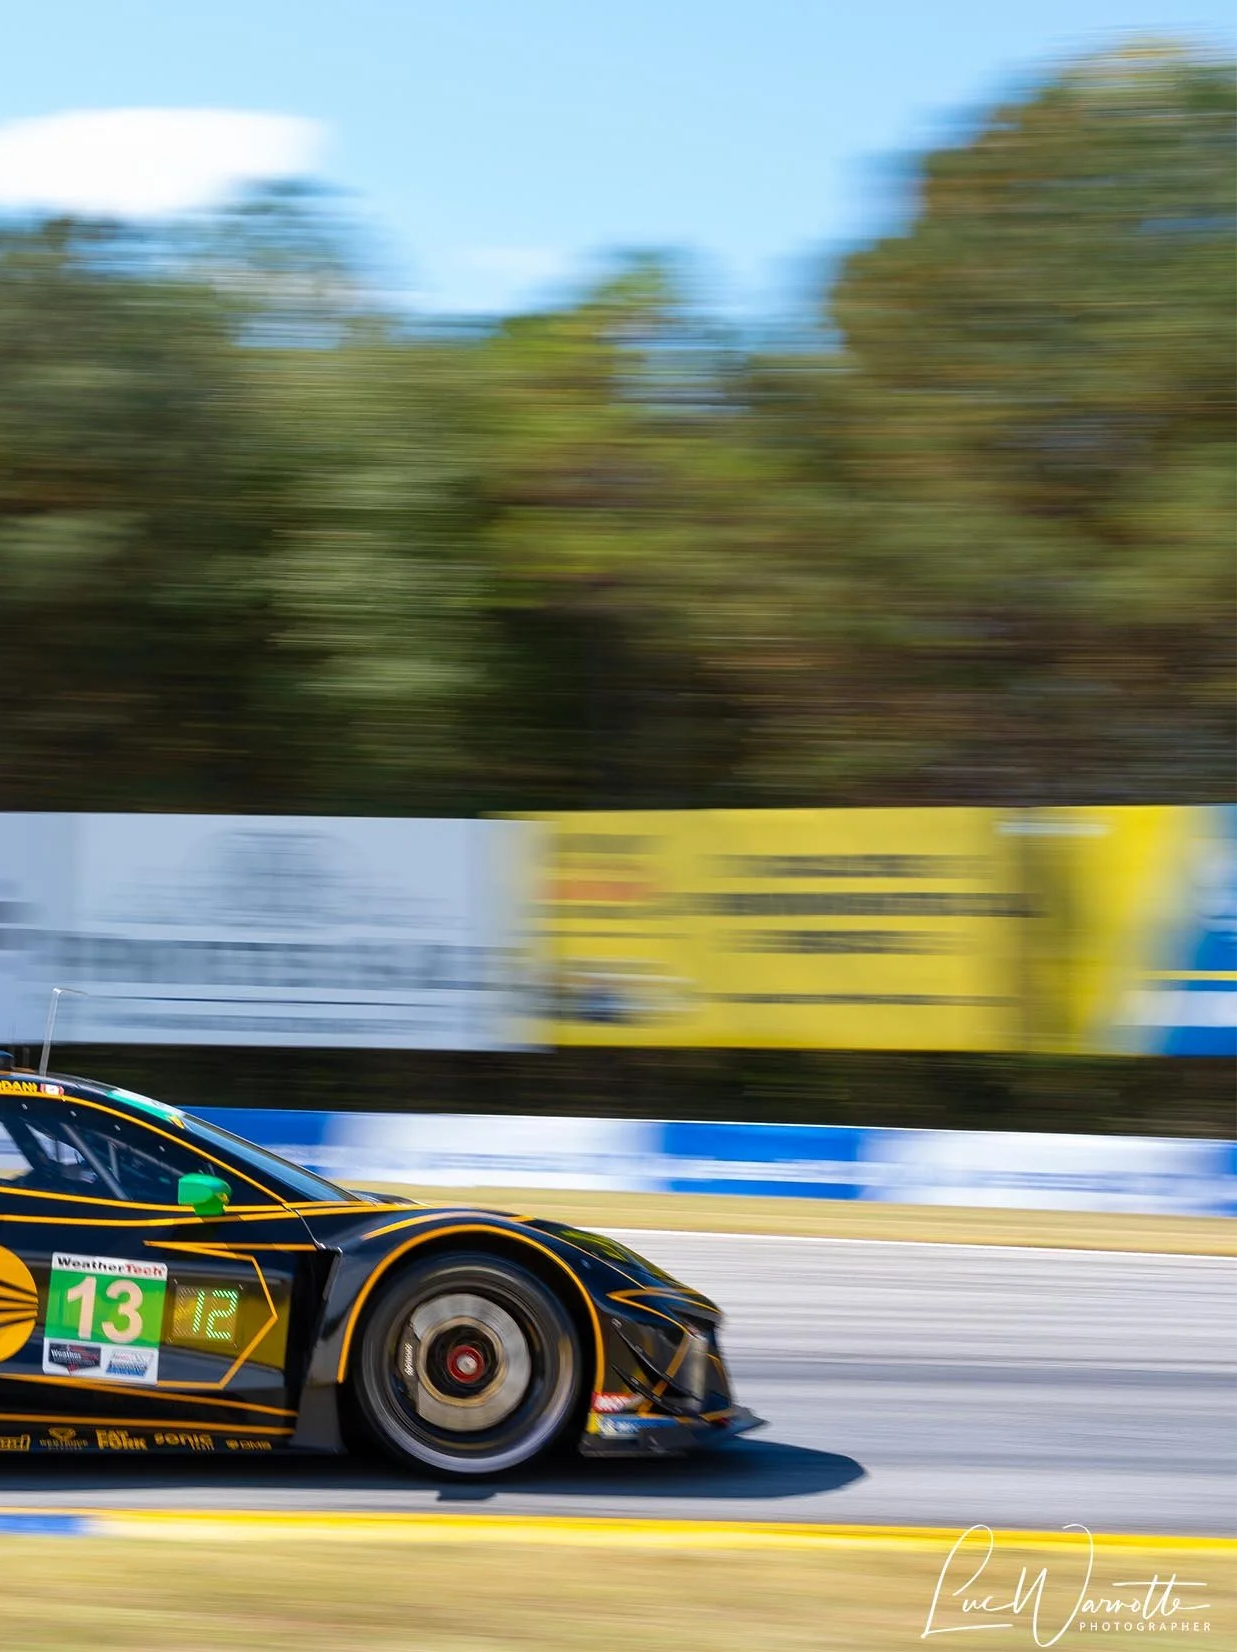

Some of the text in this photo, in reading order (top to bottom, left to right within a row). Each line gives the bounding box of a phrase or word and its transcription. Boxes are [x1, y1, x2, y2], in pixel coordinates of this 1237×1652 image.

[57, 1256, 163, 1276] WeatherTech
[67, 1275, 143, 1344] 13
[192, 1289, 239, 1340] 12
